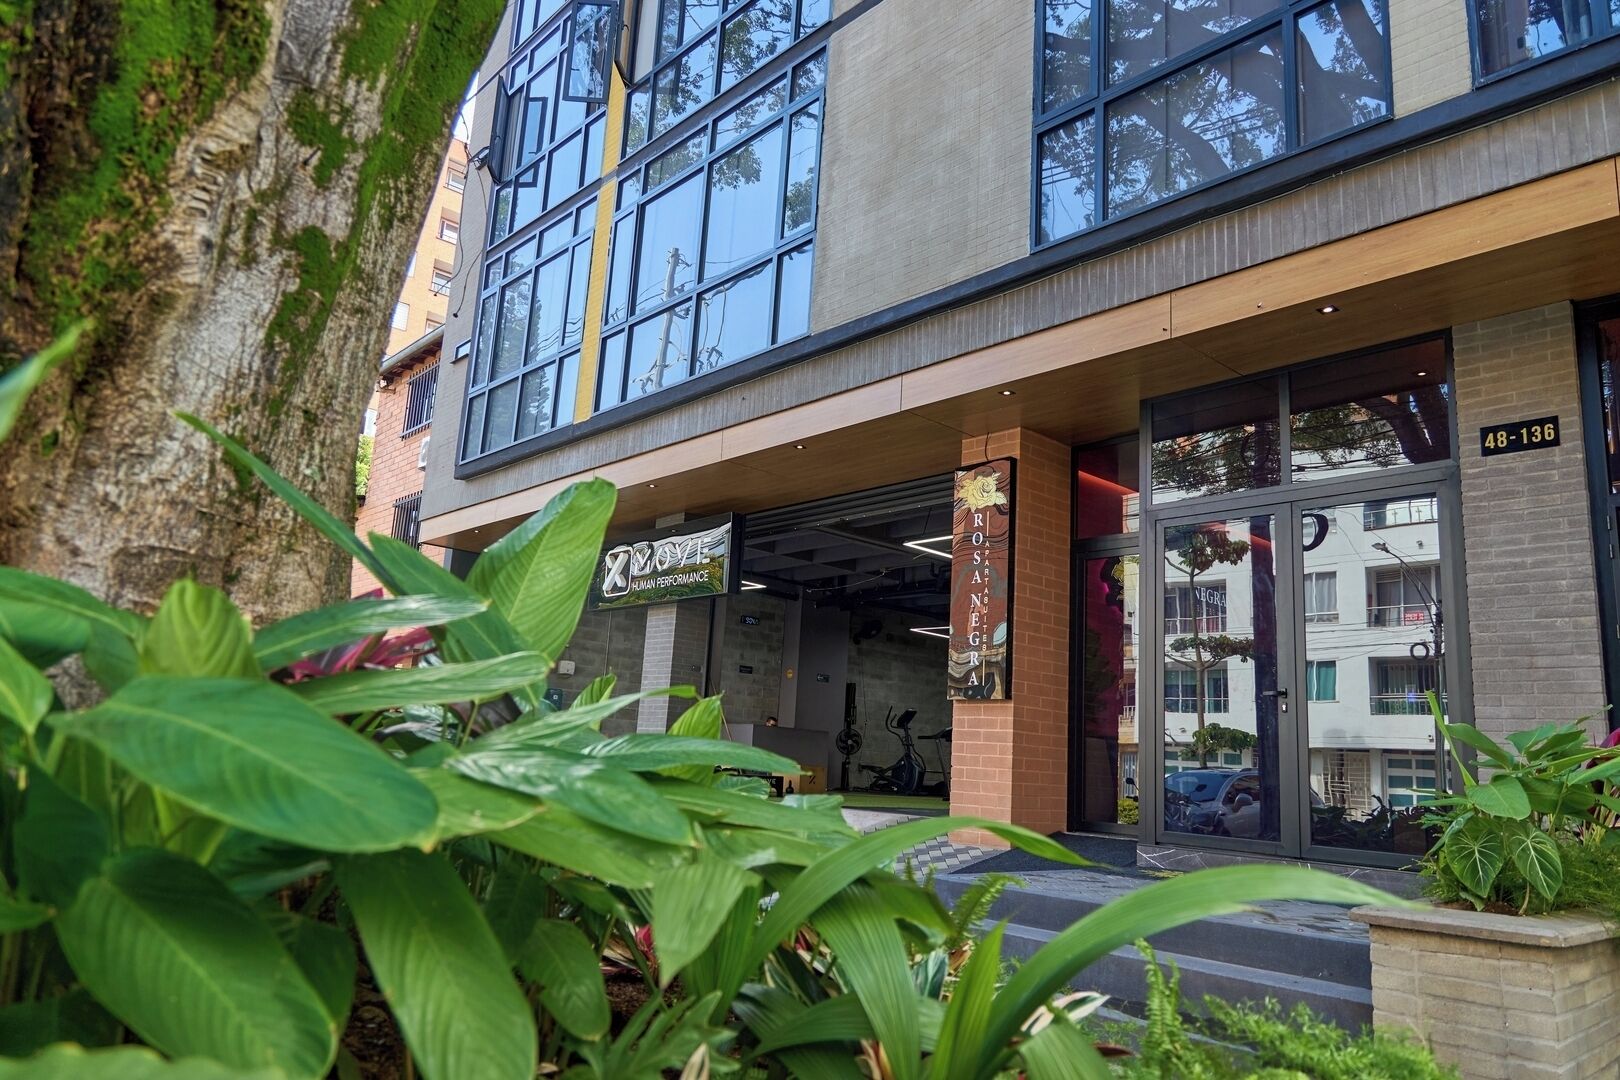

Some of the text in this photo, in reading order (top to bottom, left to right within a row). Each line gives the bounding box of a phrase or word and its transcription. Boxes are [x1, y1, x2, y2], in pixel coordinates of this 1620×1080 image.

[1484, 423, 1555, 449] 48-136
[632, 570, 709, 591] HUMAN PERFORMANCE
[967, 513, 984, 686] ROSA NEGRA
[982, 540, 990, 652] APARTASUITES
